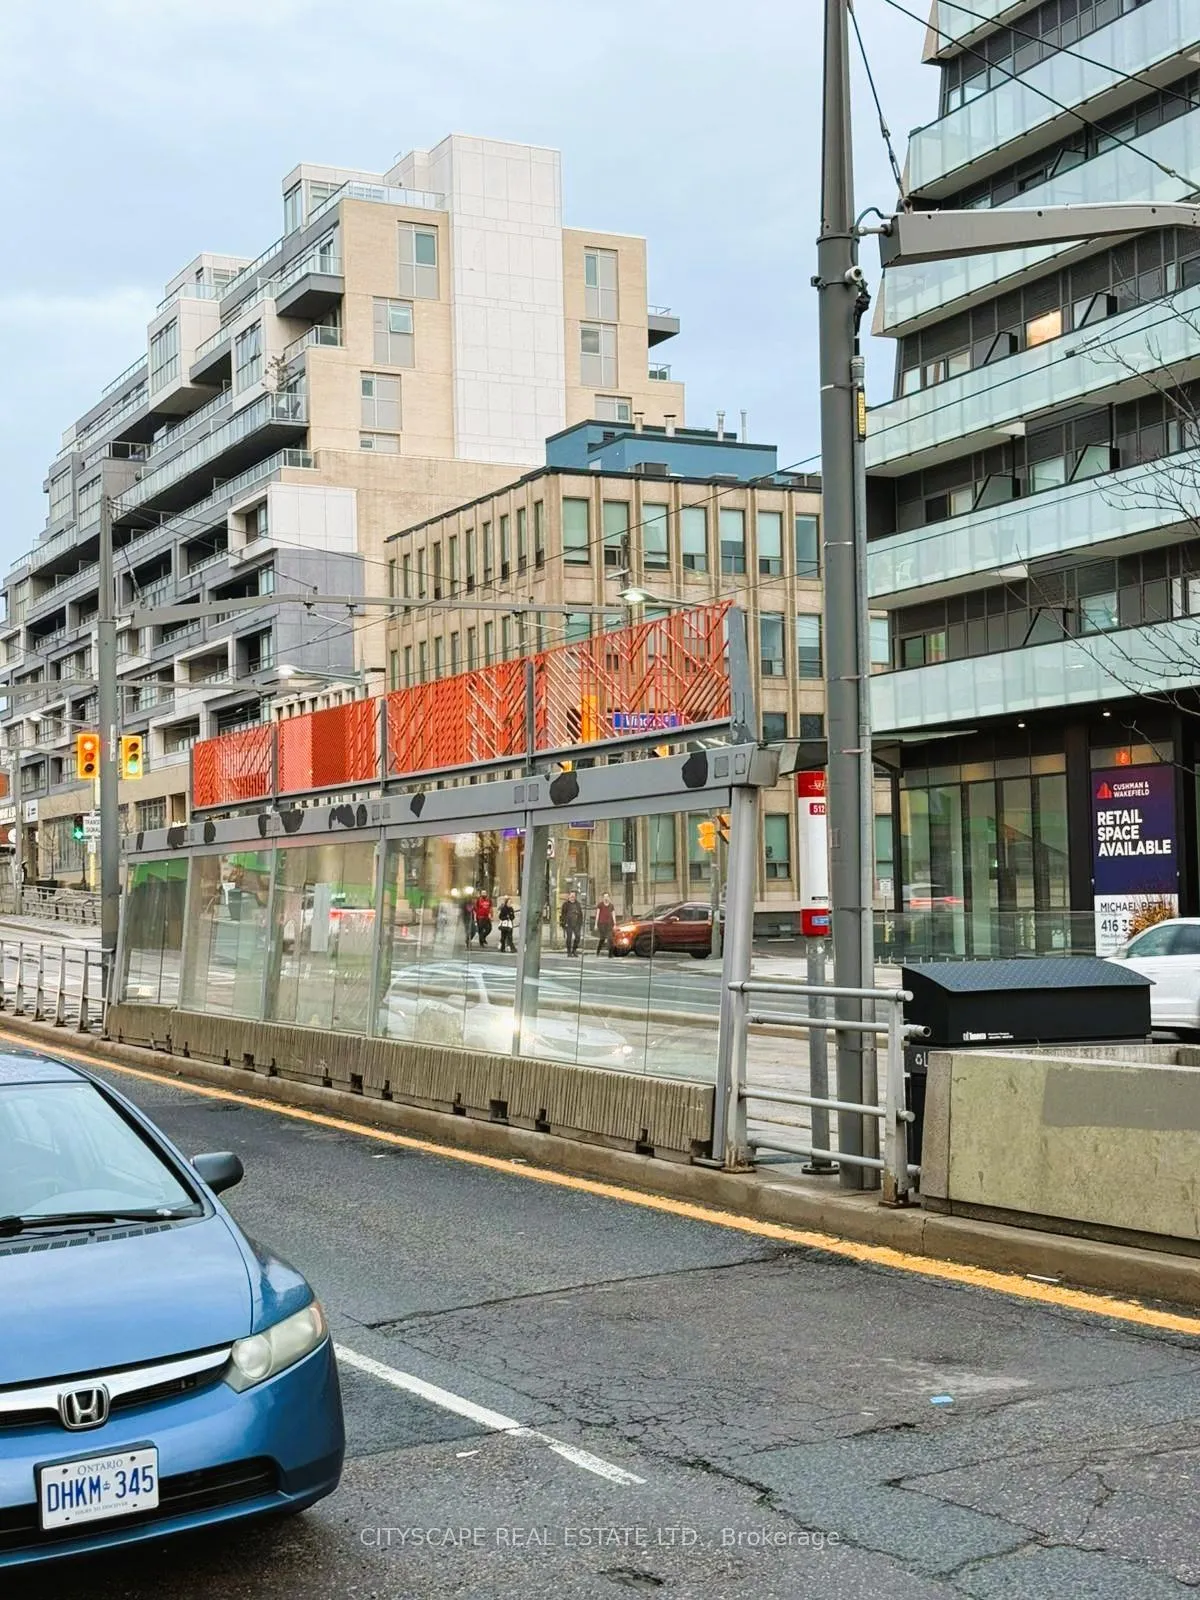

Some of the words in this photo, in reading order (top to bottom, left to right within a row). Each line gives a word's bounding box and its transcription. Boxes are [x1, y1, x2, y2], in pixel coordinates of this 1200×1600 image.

[1113, 782, 1144, 791] CUSHMAN
[1144, 781, 1149, 789] &
[1113, 789, 1150, 798] WAKEFIELD
[813, 804, 825, 813] 512
[1097, 809, 1143, 826] RETAIL
[1097, 825, 1140, 842] SPACE
[1098, 839, 1172, 857] AVAILABLE
[1100, 902, 1139, 912] MICHAEL
[1101, 919, 1119, 932] 416
[77, 1459, 123, 1475] ONTARIO
[47, 1474, 102, 1512] DHKM
[114, 1464, 154, 1499] 345
